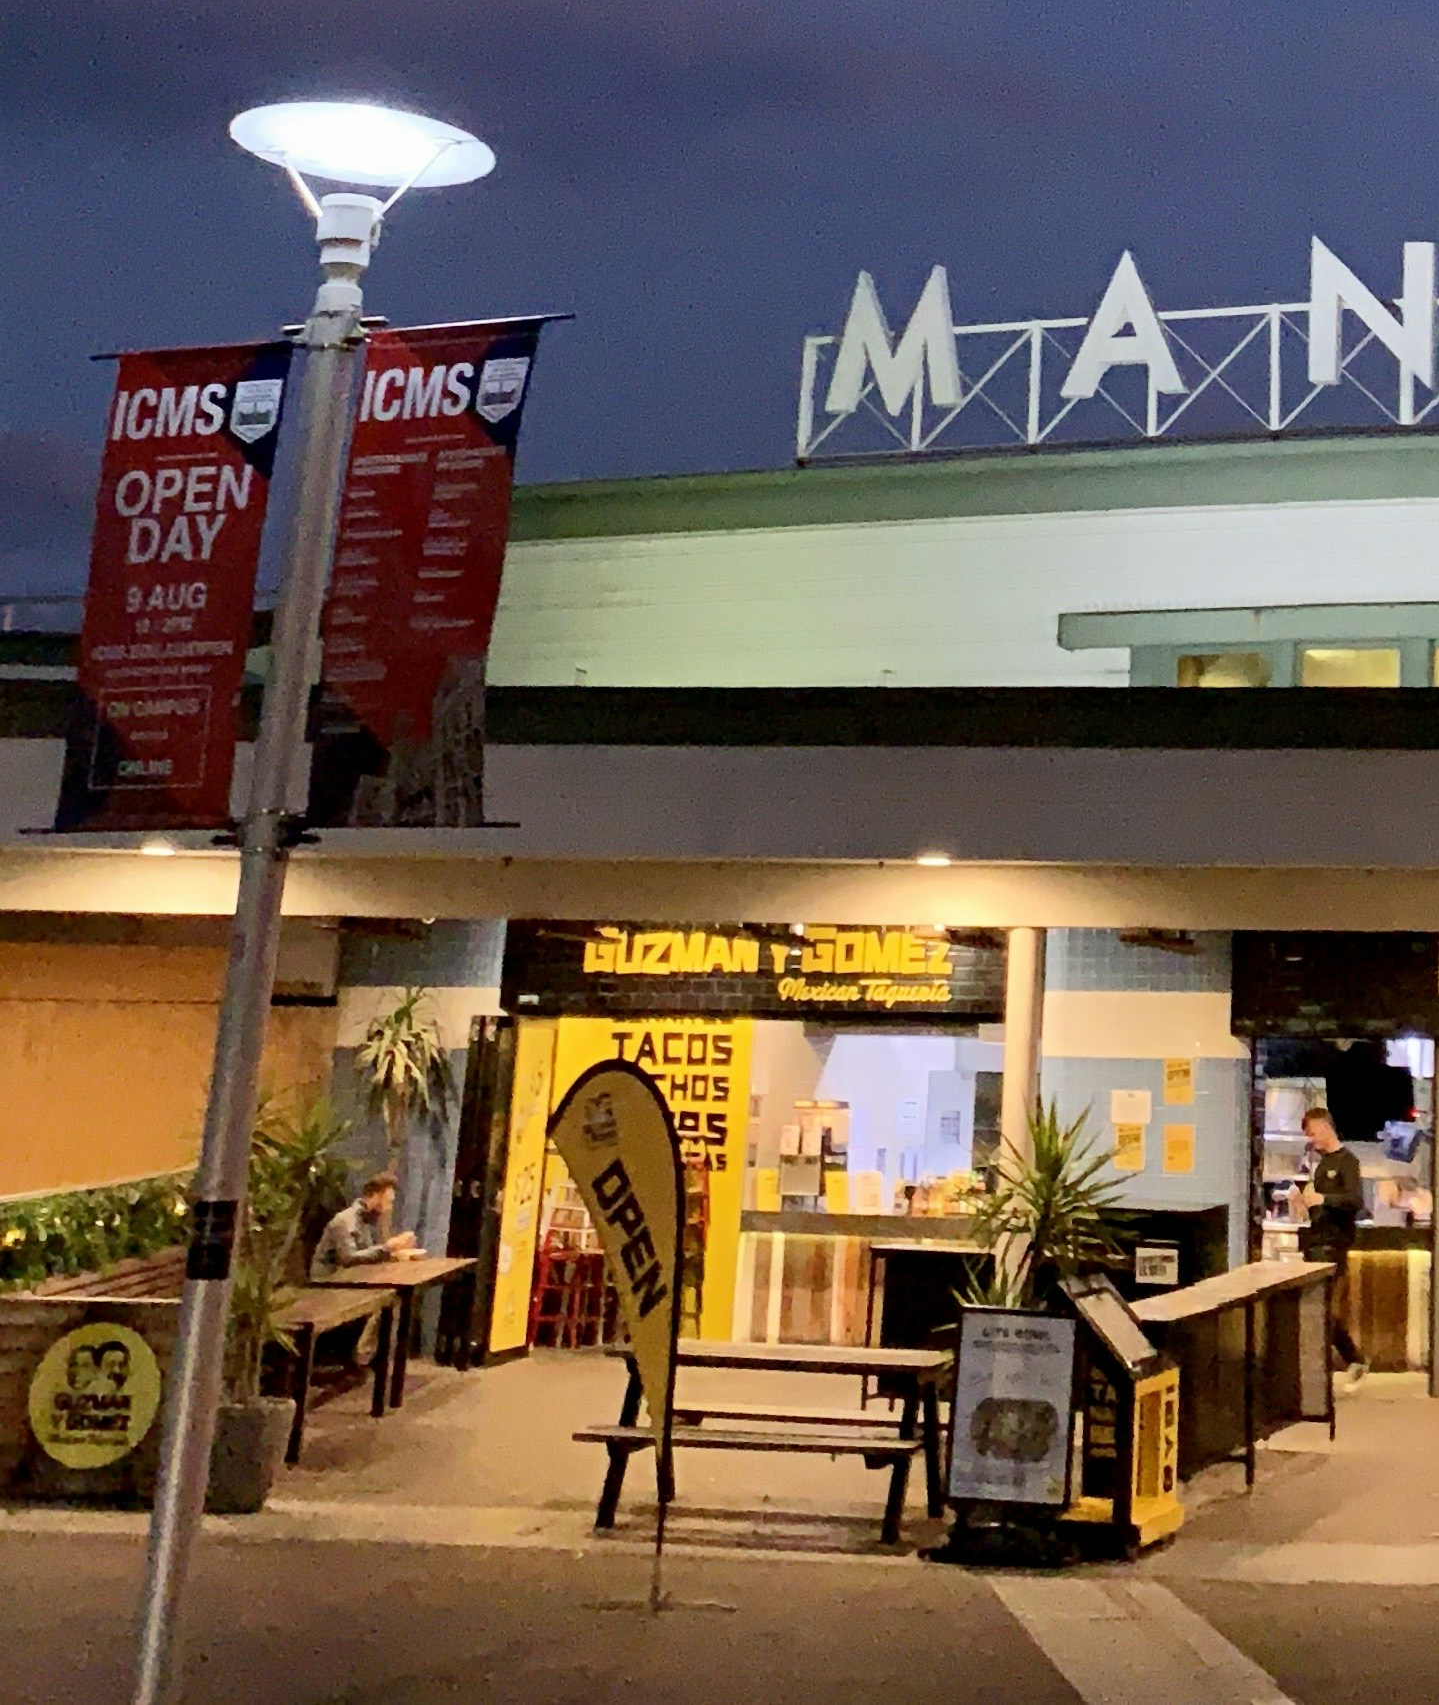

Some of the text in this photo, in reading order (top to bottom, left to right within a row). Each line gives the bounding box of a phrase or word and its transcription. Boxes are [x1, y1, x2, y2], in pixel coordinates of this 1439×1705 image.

[111, 383, 227, 440] ICMS
[358, 362, 475, 422] ICMS
[115, 464, 254, 516] OPEN
[127, 514, 228, 564] DAY
[126, 582, 207, 613] 9 AUG
[583, 927, 760, 975] GUZMAN
[802, 927, 953, 975] GOMEZ
[778, 977, 953, 1009] Mexican Taqueria
[612, 1031, 734, 1067] TACOS
[592, 1158, 667, 1318] OPEN
